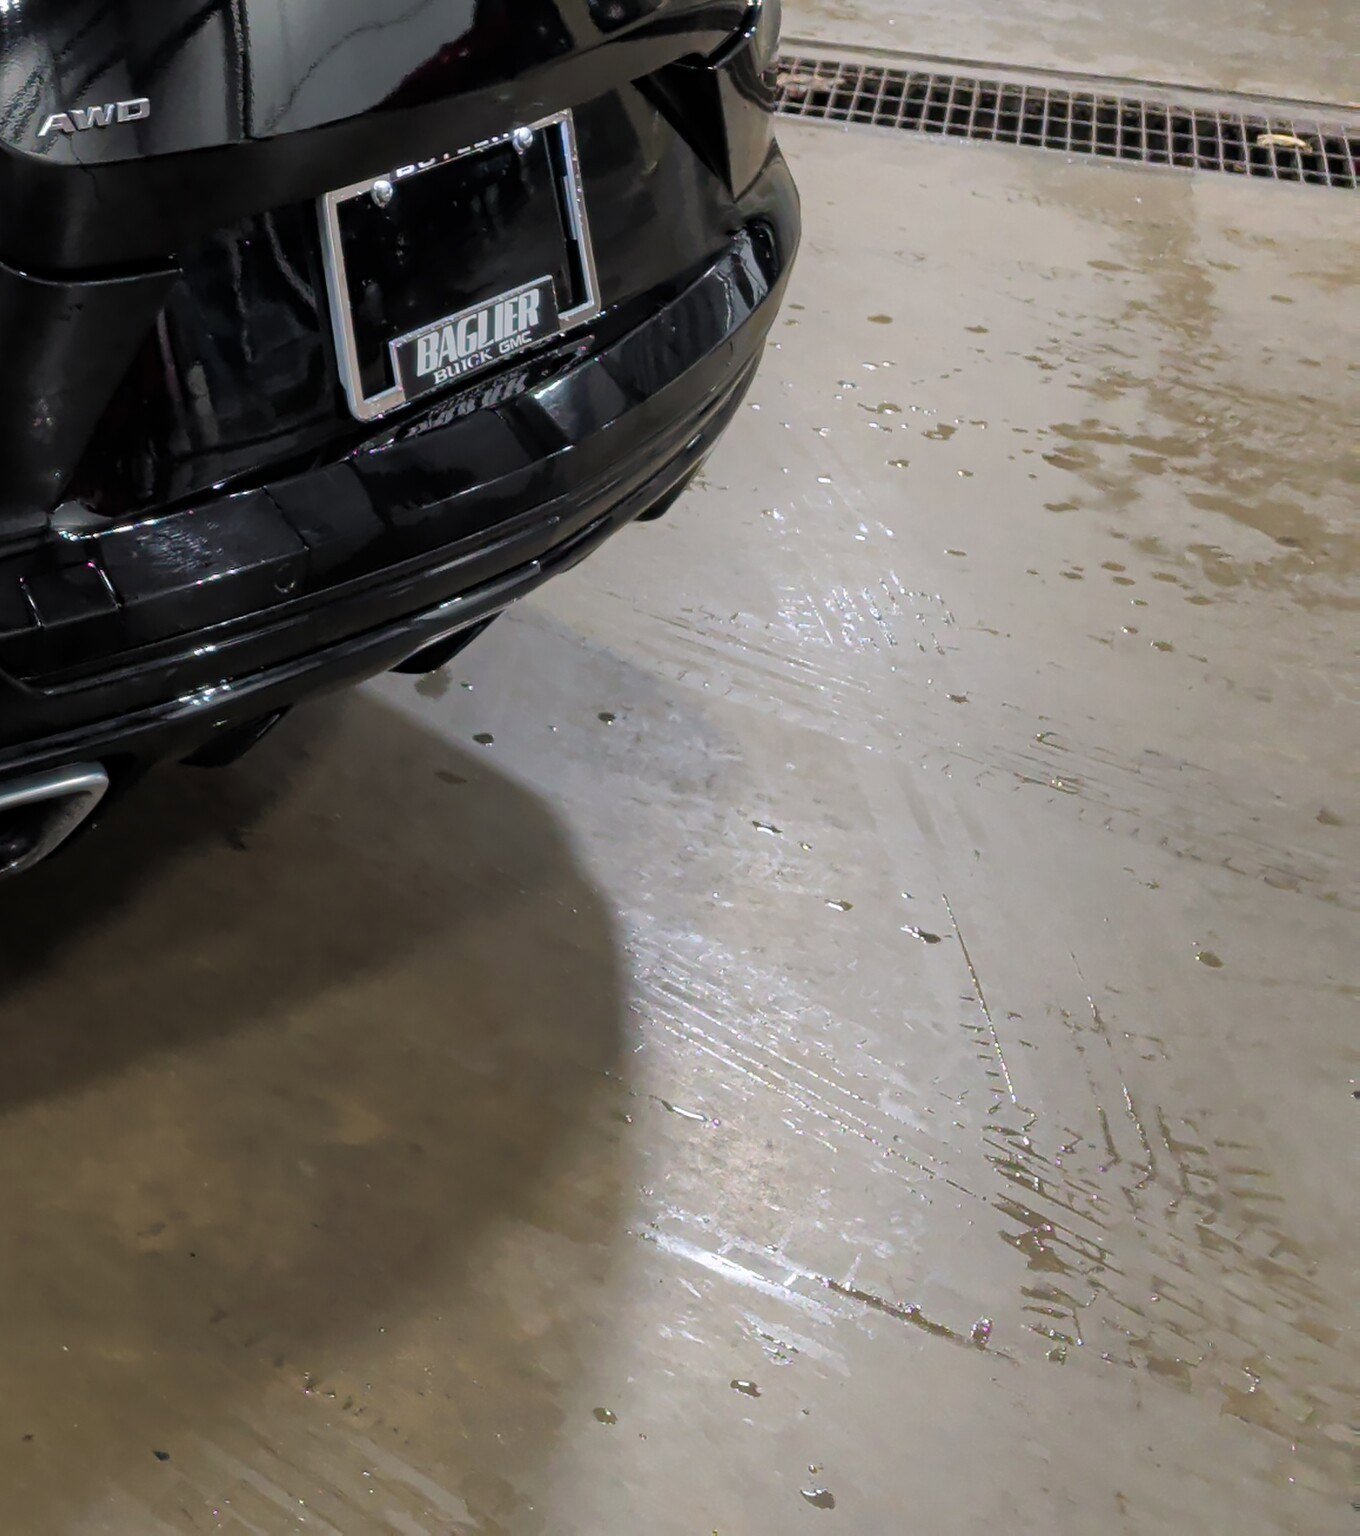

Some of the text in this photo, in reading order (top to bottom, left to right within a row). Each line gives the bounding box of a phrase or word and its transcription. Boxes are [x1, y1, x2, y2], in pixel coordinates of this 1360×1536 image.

[36, 97, 151, 137] AWD
[416, 288, 540, 377] BAGLIER
[433, 331, 533, 385] BUICK GMC
